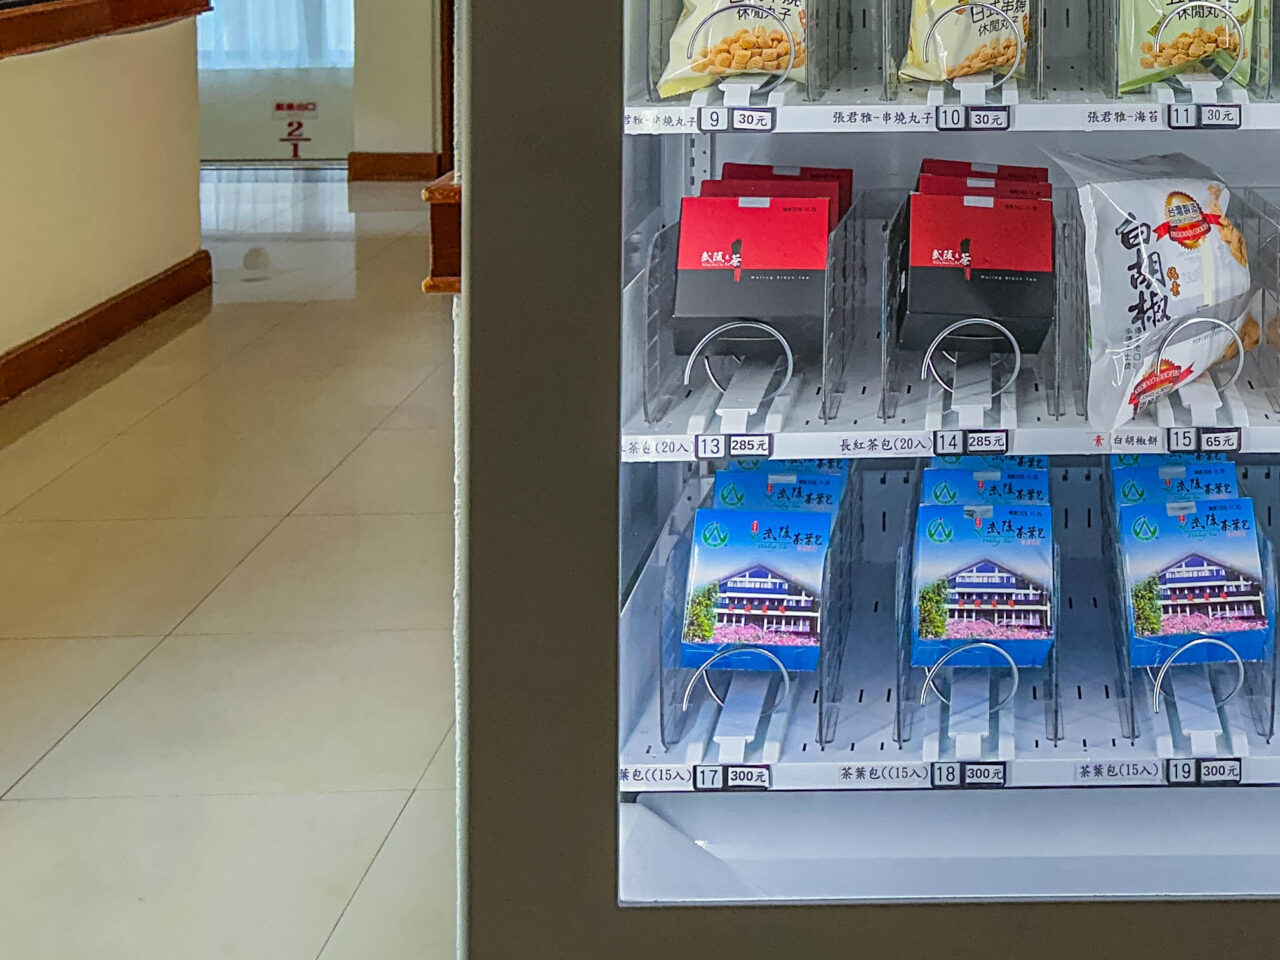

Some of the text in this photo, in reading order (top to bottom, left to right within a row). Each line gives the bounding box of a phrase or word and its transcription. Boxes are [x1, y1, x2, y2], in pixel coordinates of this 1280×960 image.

[709, 111, 720, 128] 9
[738, 113, 768, 127] 30元
[941, 109, 960, 126] 10
[974, 113, 1003, 126] 30元
[1087, 109, 1159, 124] 張君雅-海苔
[1173, 107, 1190, 124] 11
[1207, 109, 1235, 122] 30元
[287, 120, 304, 137] 2
[291, 142, 300, 159] 1
[1114, 211, 1172, 332] 白胡椒
[701, 438, 720, 455] 13
[731, 439, 768, 451] 285元
[839, 437, 933, 452] 長紅茶包(20入)
[939, 434, 958, 451] 14
[968, 435, 1005, 447] 285元
[1092, 434, 1158, 448] 素 白胡椒餅
[1173, 430, 1192, 447] 15
[1205, 435, 1235, 447] 65元
[700, 769, 719, 786] 17
[730, 770, 767, 783] 300元
[936, 765, 956, 782] 18
[967, 768, 1004, 780] 300元
[1078, 762, 1160, 778] 茶葉包(15入)
[1172, 762, 1192, 779] 19
[1202, 765, 1239, 777] 300元
